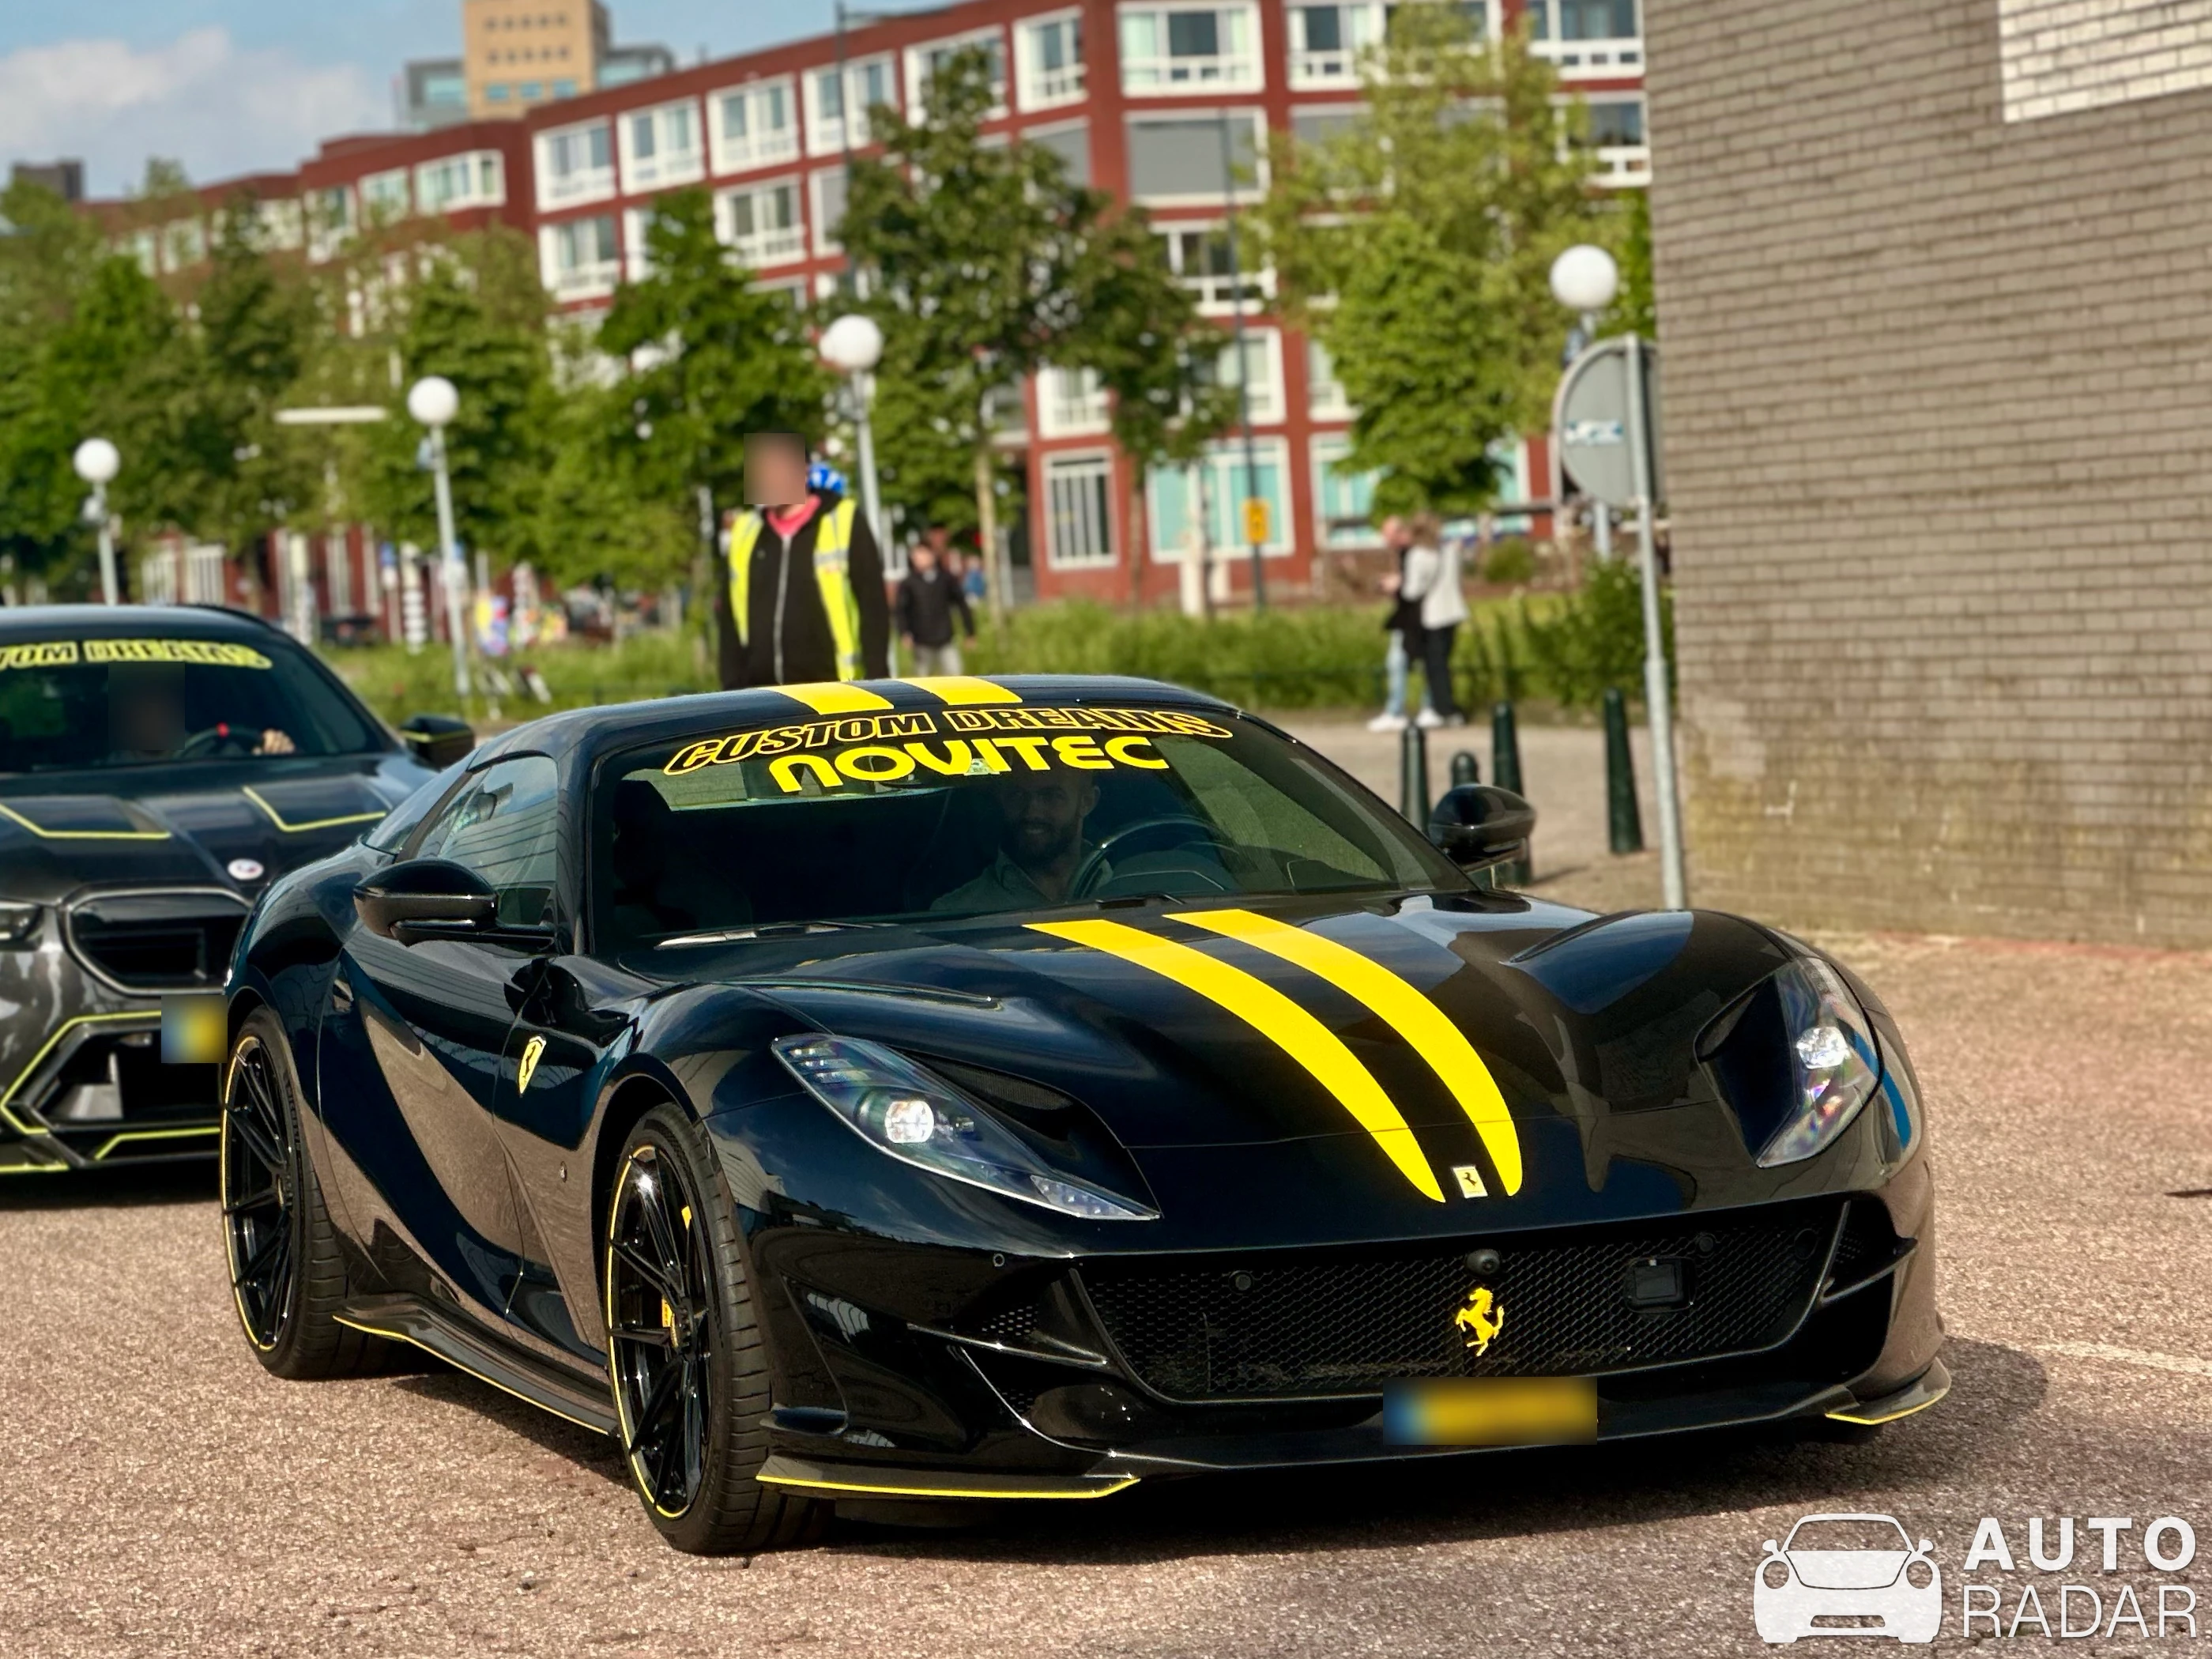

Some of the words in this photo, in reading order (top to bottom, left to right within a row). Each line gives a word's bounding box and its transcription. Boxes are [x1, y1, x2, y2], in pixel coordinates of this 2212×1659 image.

[662, 712, 937, 776] CUSTOM
[950, 707, 1234, 738] DREAMS
[767, 736, 1169, 793] NOVITEC
